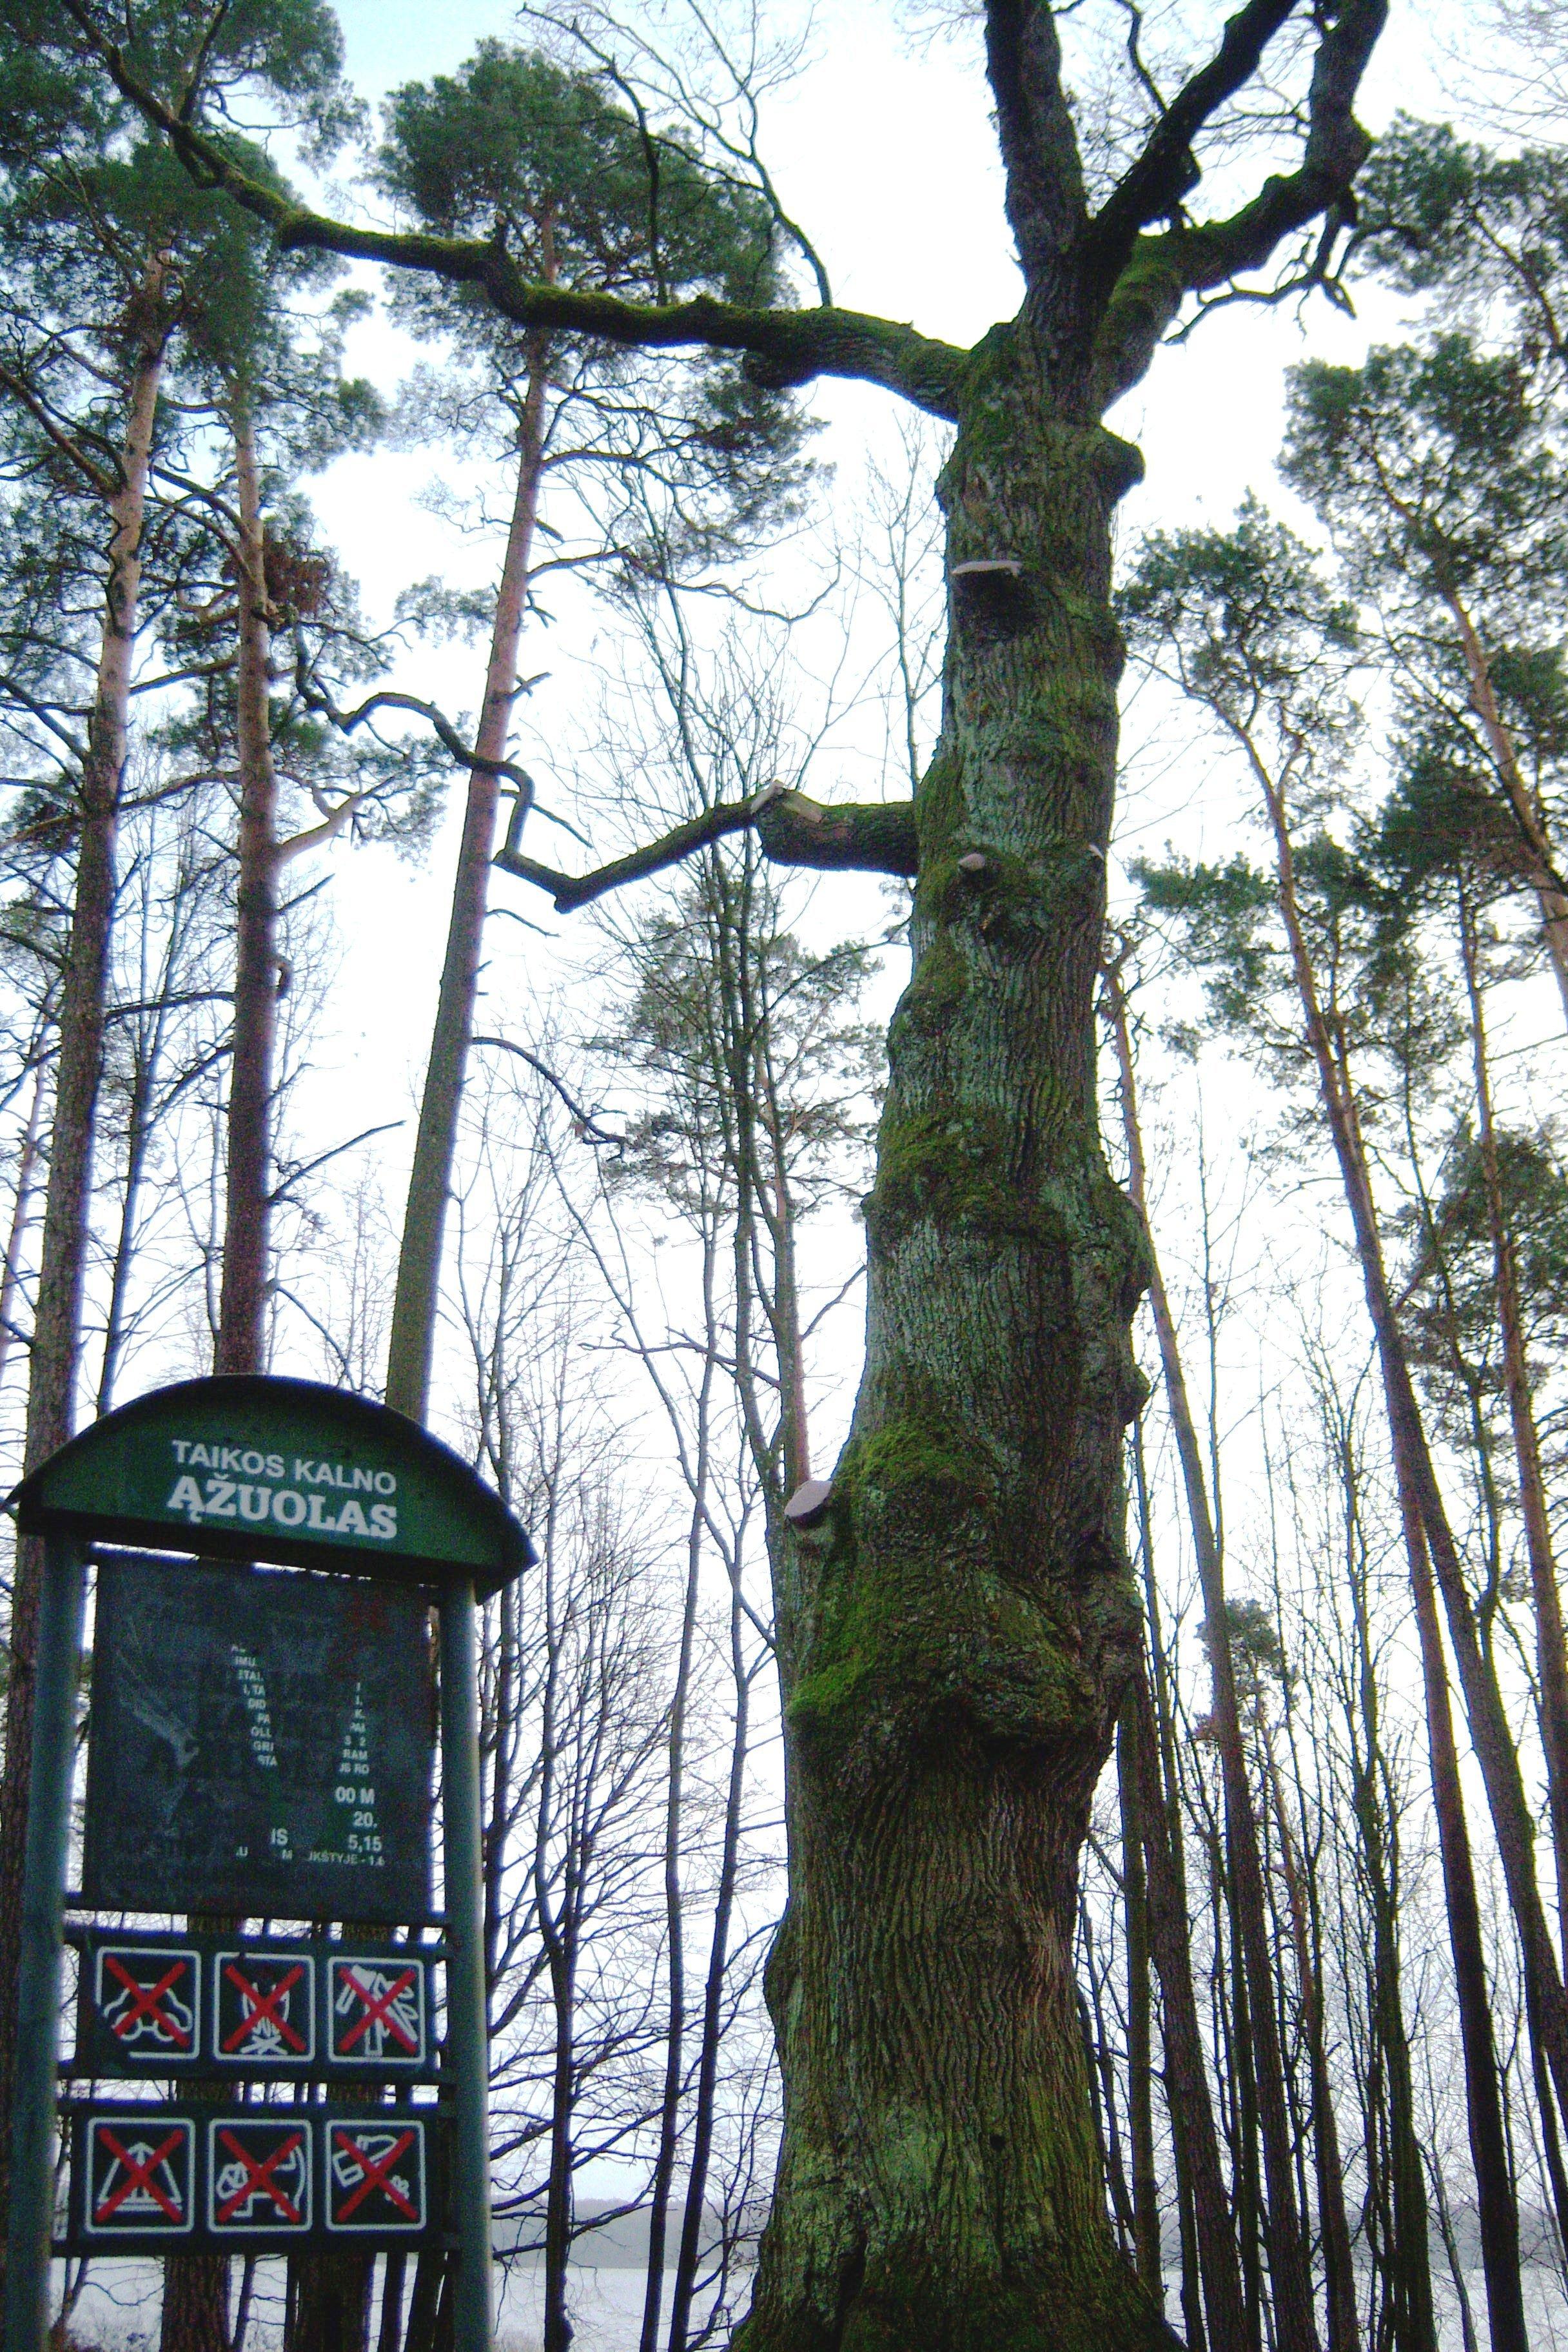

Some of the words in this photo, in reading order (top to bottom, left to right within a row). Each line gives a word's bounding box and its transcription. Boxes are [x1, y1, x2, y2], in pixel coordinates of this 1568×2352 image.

[172, 1439, 286, 1478] TAIKOS
[293, 1458, 397, 1495] KALNO
[166, 1473, 398, 1540] ĄŽUOLAS
